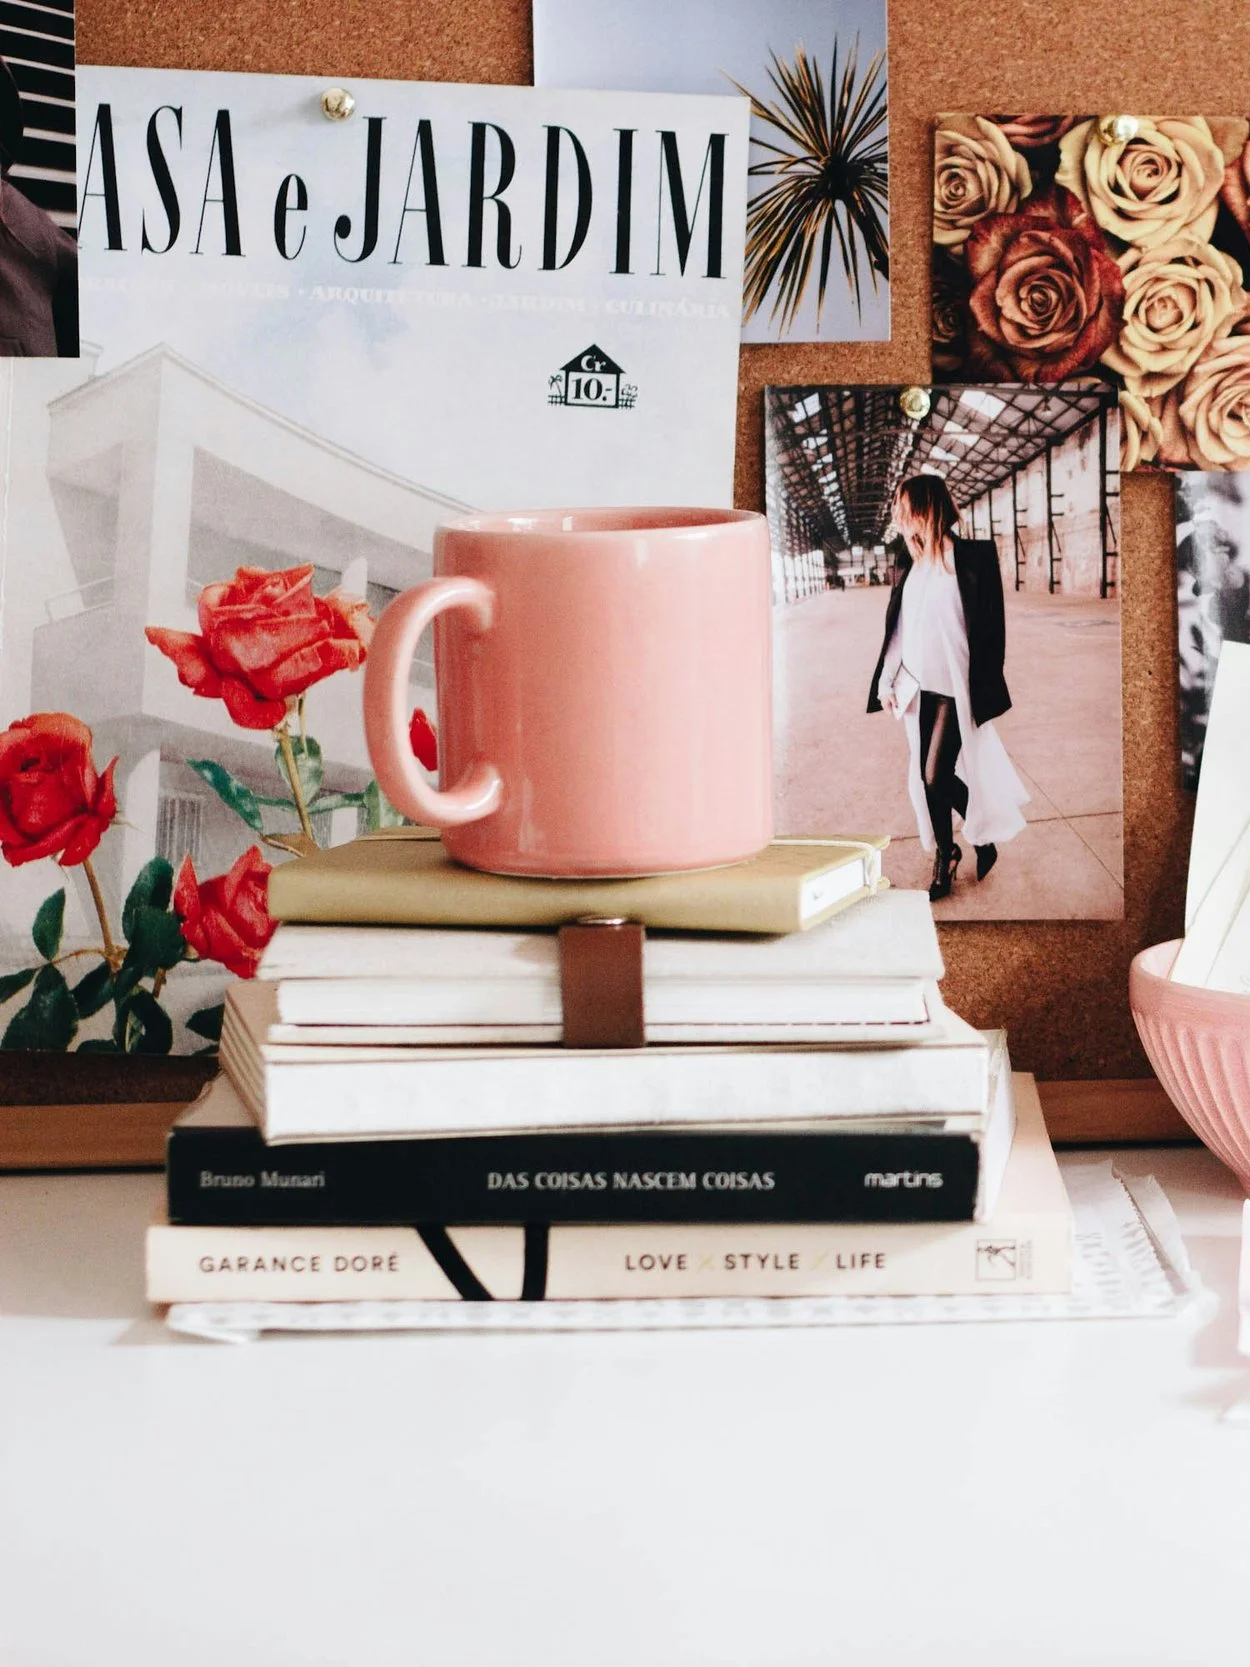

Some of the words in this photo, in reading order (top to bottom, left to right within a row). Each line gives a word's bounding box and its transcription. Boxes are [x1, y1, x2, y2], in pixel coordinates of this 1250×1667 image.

[273, 172, 309, 261] e
[333, 115, 730, 280] JARDIM
[200, 1170, 255, 1188] Bruno
[260, 1170, 325, 1188] Munari
[486, 1171, 529, 1191] DAS
[534, 1171, 608, 1191] COISAS
[612, 1171, 697, 1191] NASCEM
[702, 1171, 776, 1191] COISAS
[864, 1169, 945, 1189] martins
[198, 1255, 322, 1273] GARANCE
[333, 1251, 400, 1273] DORÉ
[624, 1253, 688, 1271] LOVE
[723, 1253, 800, 1271] STYLE
[835, 1252, 886, 1270] LIFE
